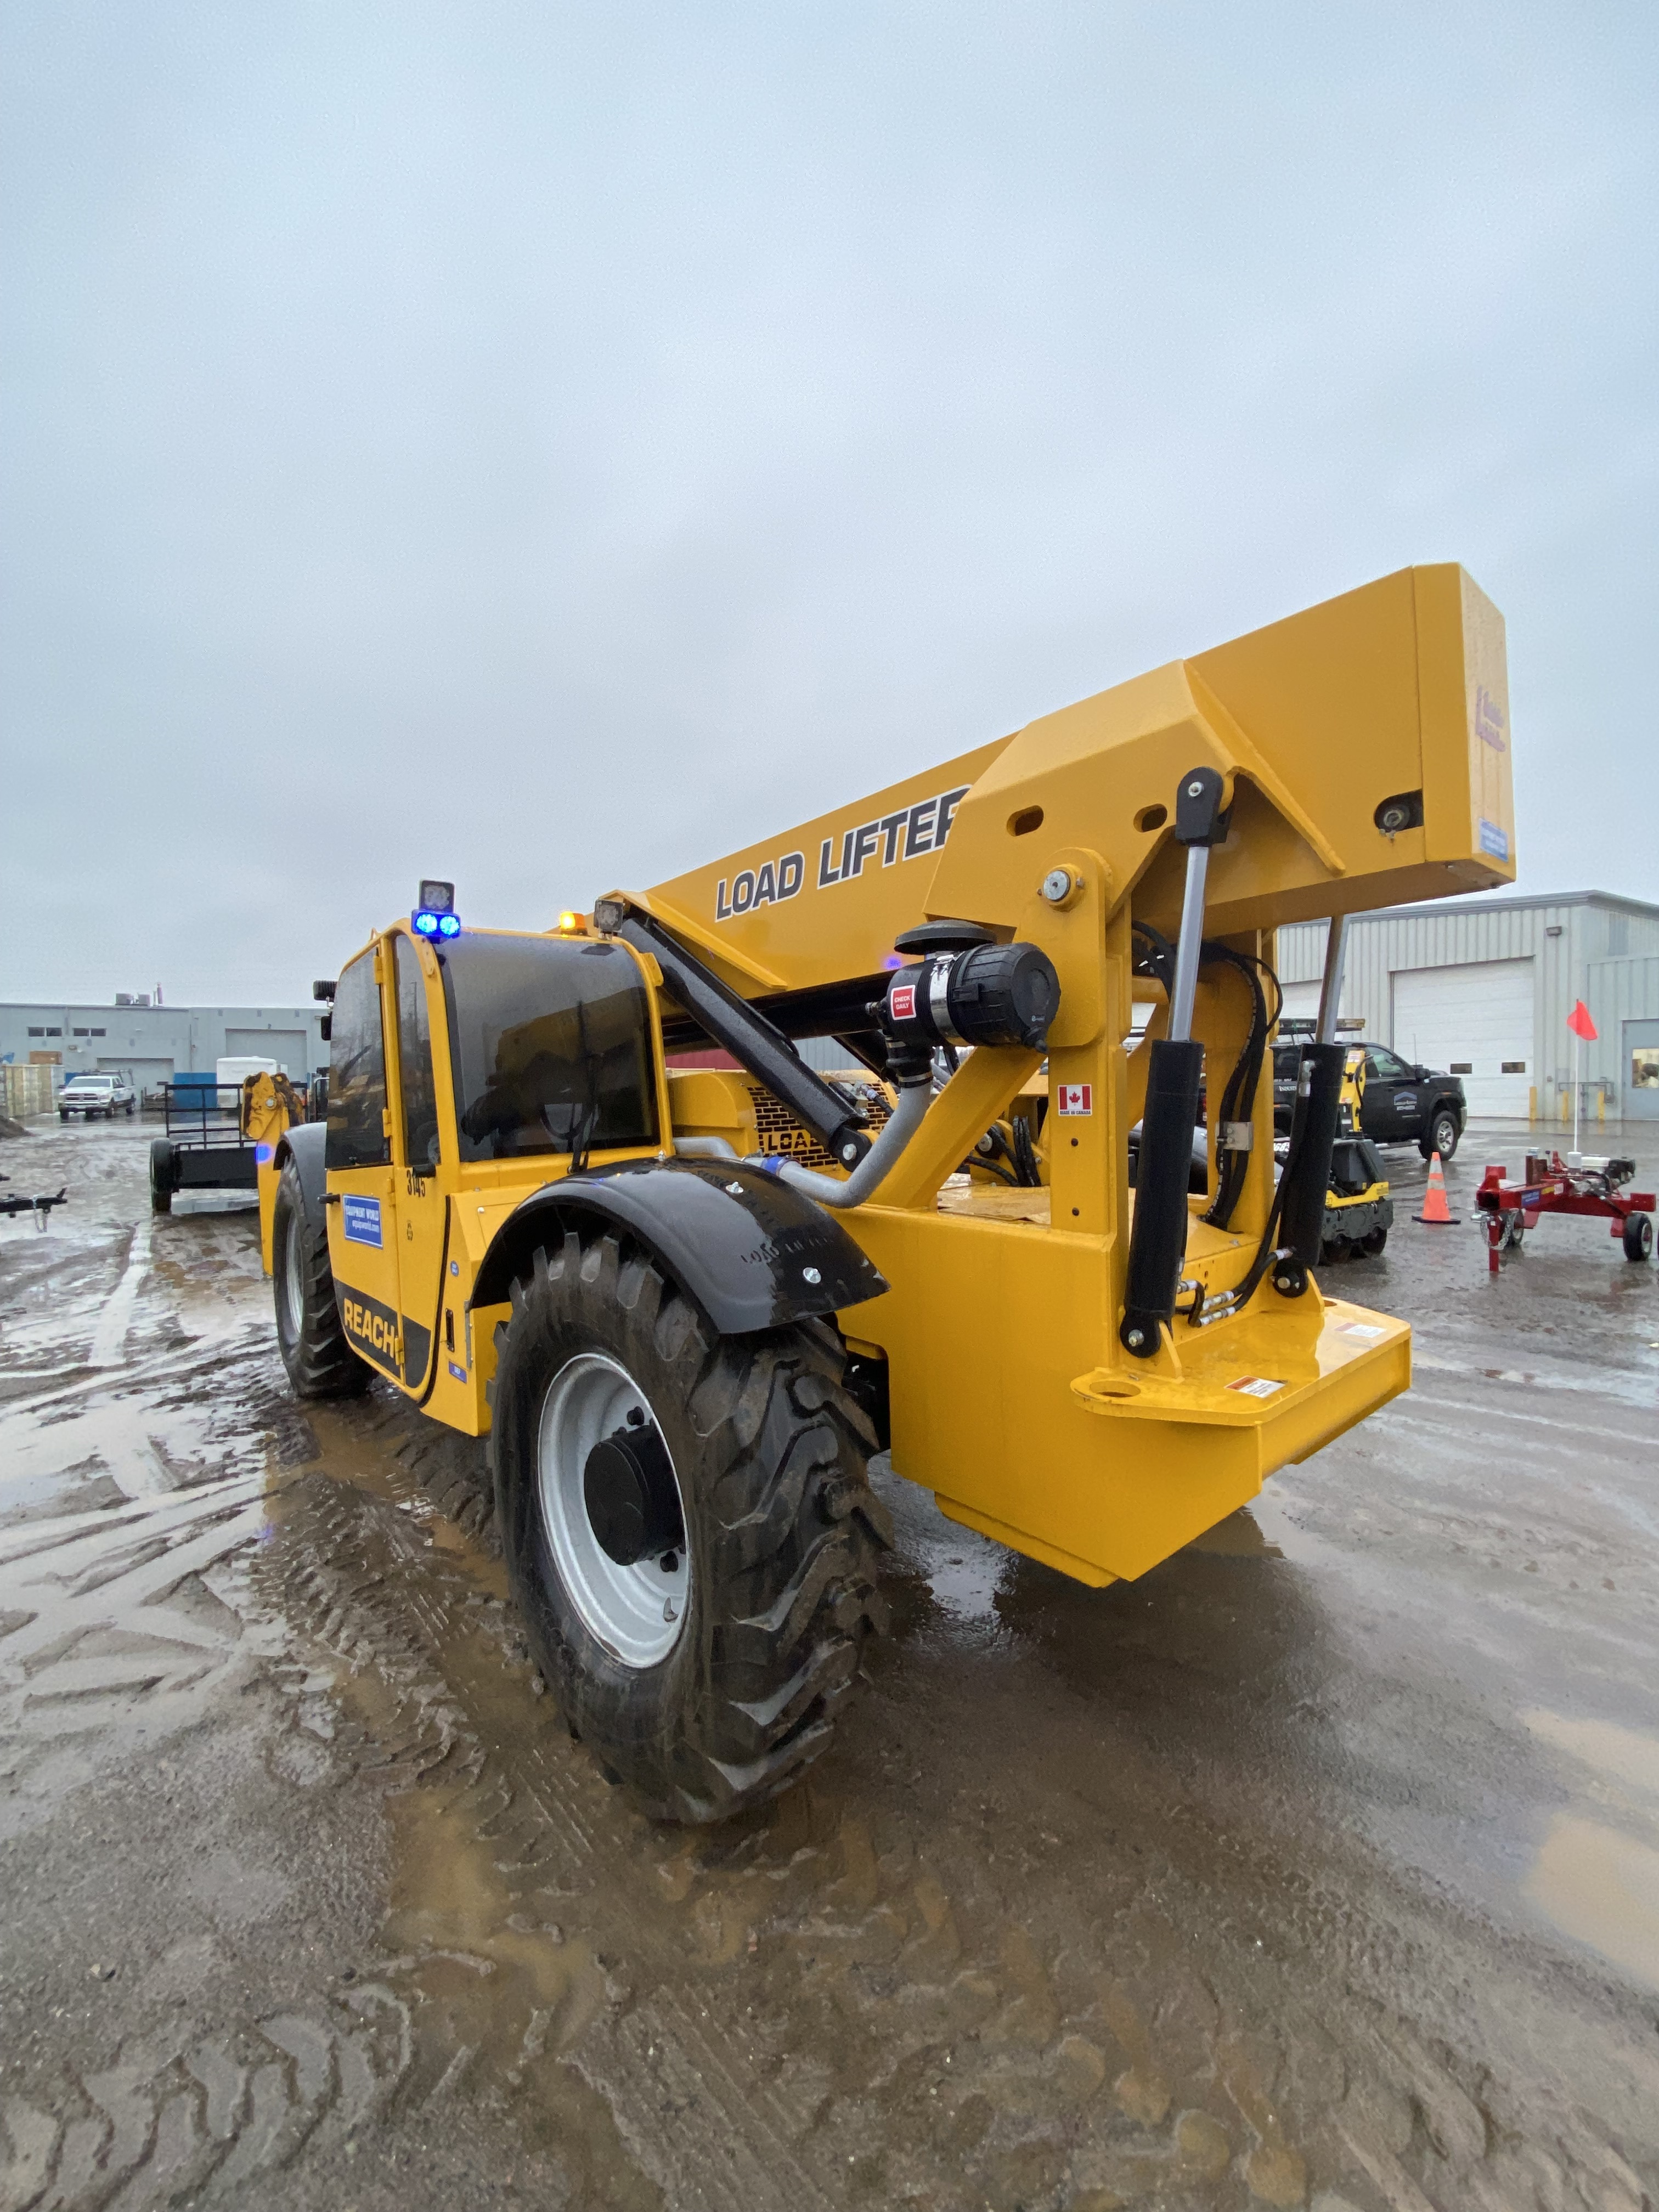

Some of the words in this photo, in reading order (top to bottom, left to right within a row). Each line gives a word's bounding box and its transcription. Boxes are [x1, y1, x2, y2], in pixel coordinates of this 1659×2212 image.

[715, 851, 805, 923] LOAD
[407, 1169, 426, 1198] 3145
[343, 1297, 394, 1358] REACH
